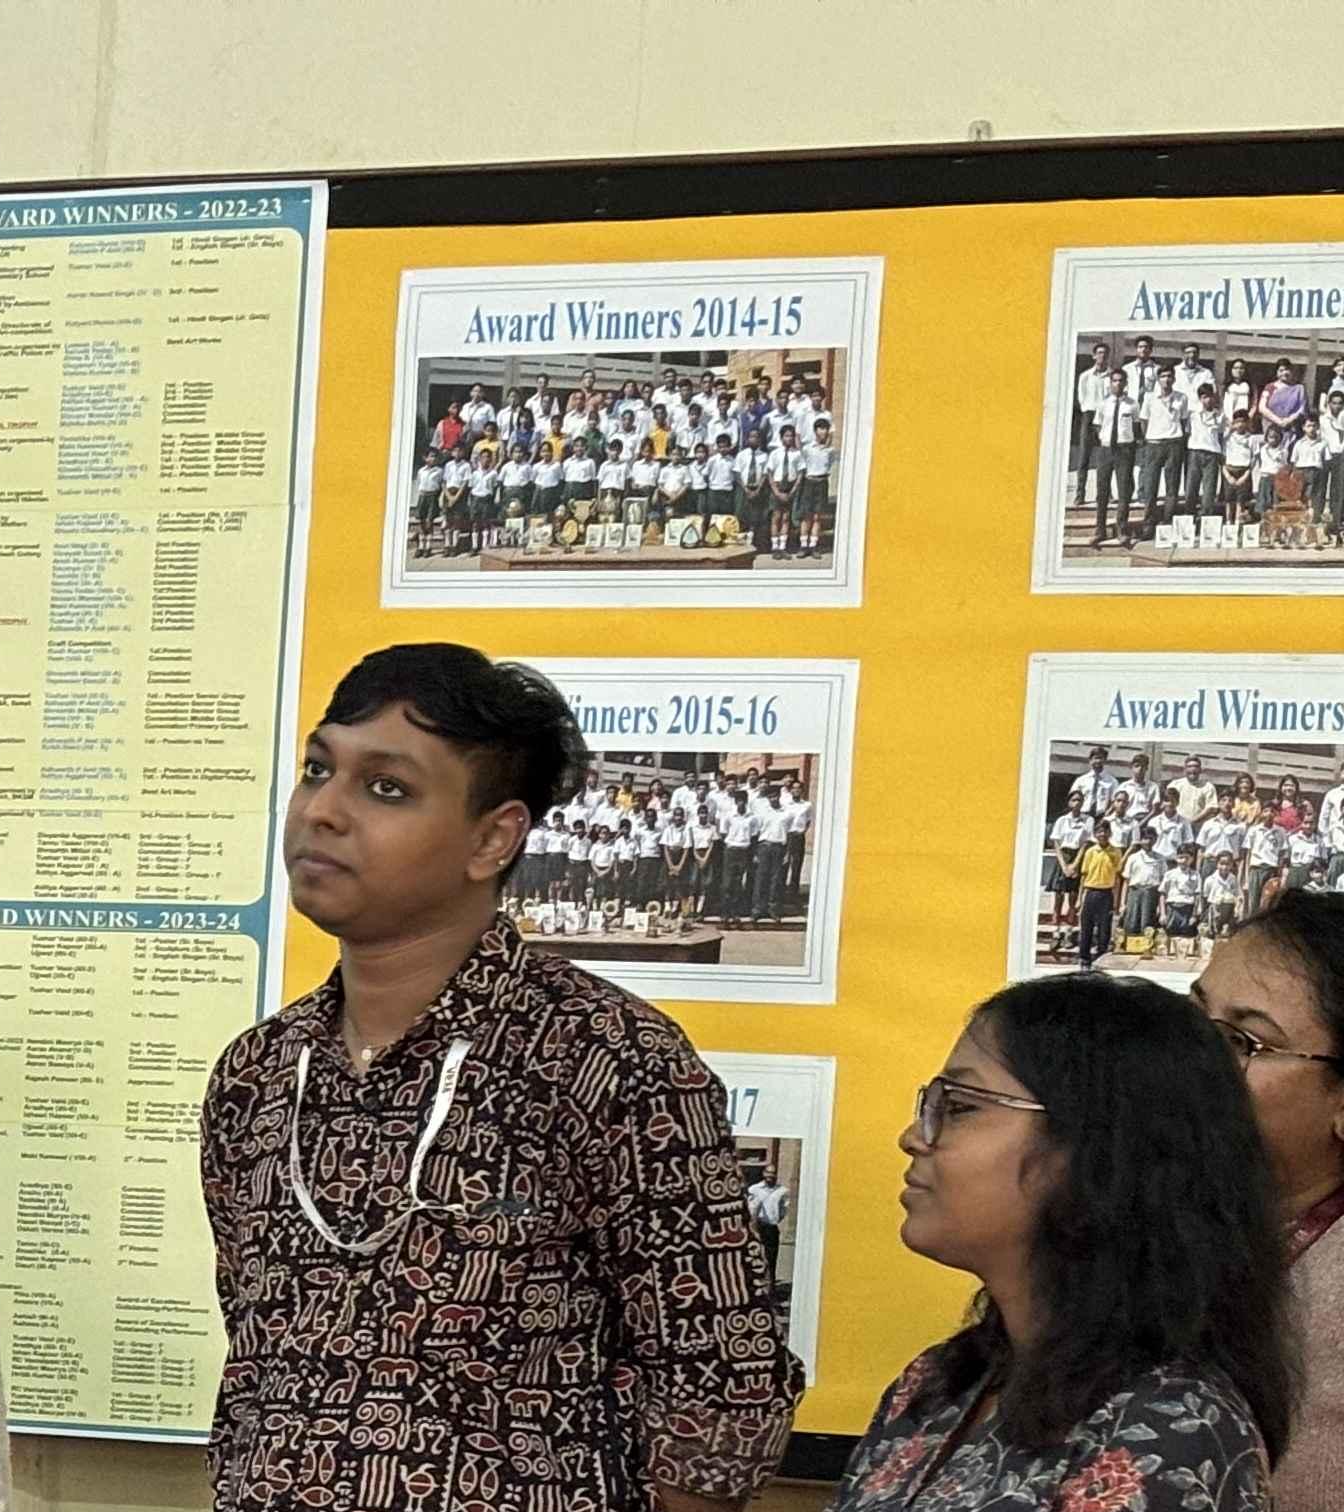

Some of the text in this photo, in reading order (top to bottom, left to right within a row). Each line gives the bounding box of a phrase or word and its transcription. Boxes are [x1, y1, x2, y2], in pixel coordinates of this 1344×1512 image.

[63, 202, 177, 225] WINNERS
[199, 197, 282, 219] 2022-23
[464, 296, 803, 343] Award Winners 2014-15
[1129, 279, 1231, 321] Award
[566, 694, 778, 736] inners 2015-16
[1104, 688, 1344, 731] Award Winners
[24, 907, 138, 928] WINNERS
[159, 912, 241, 931] 2023-24
